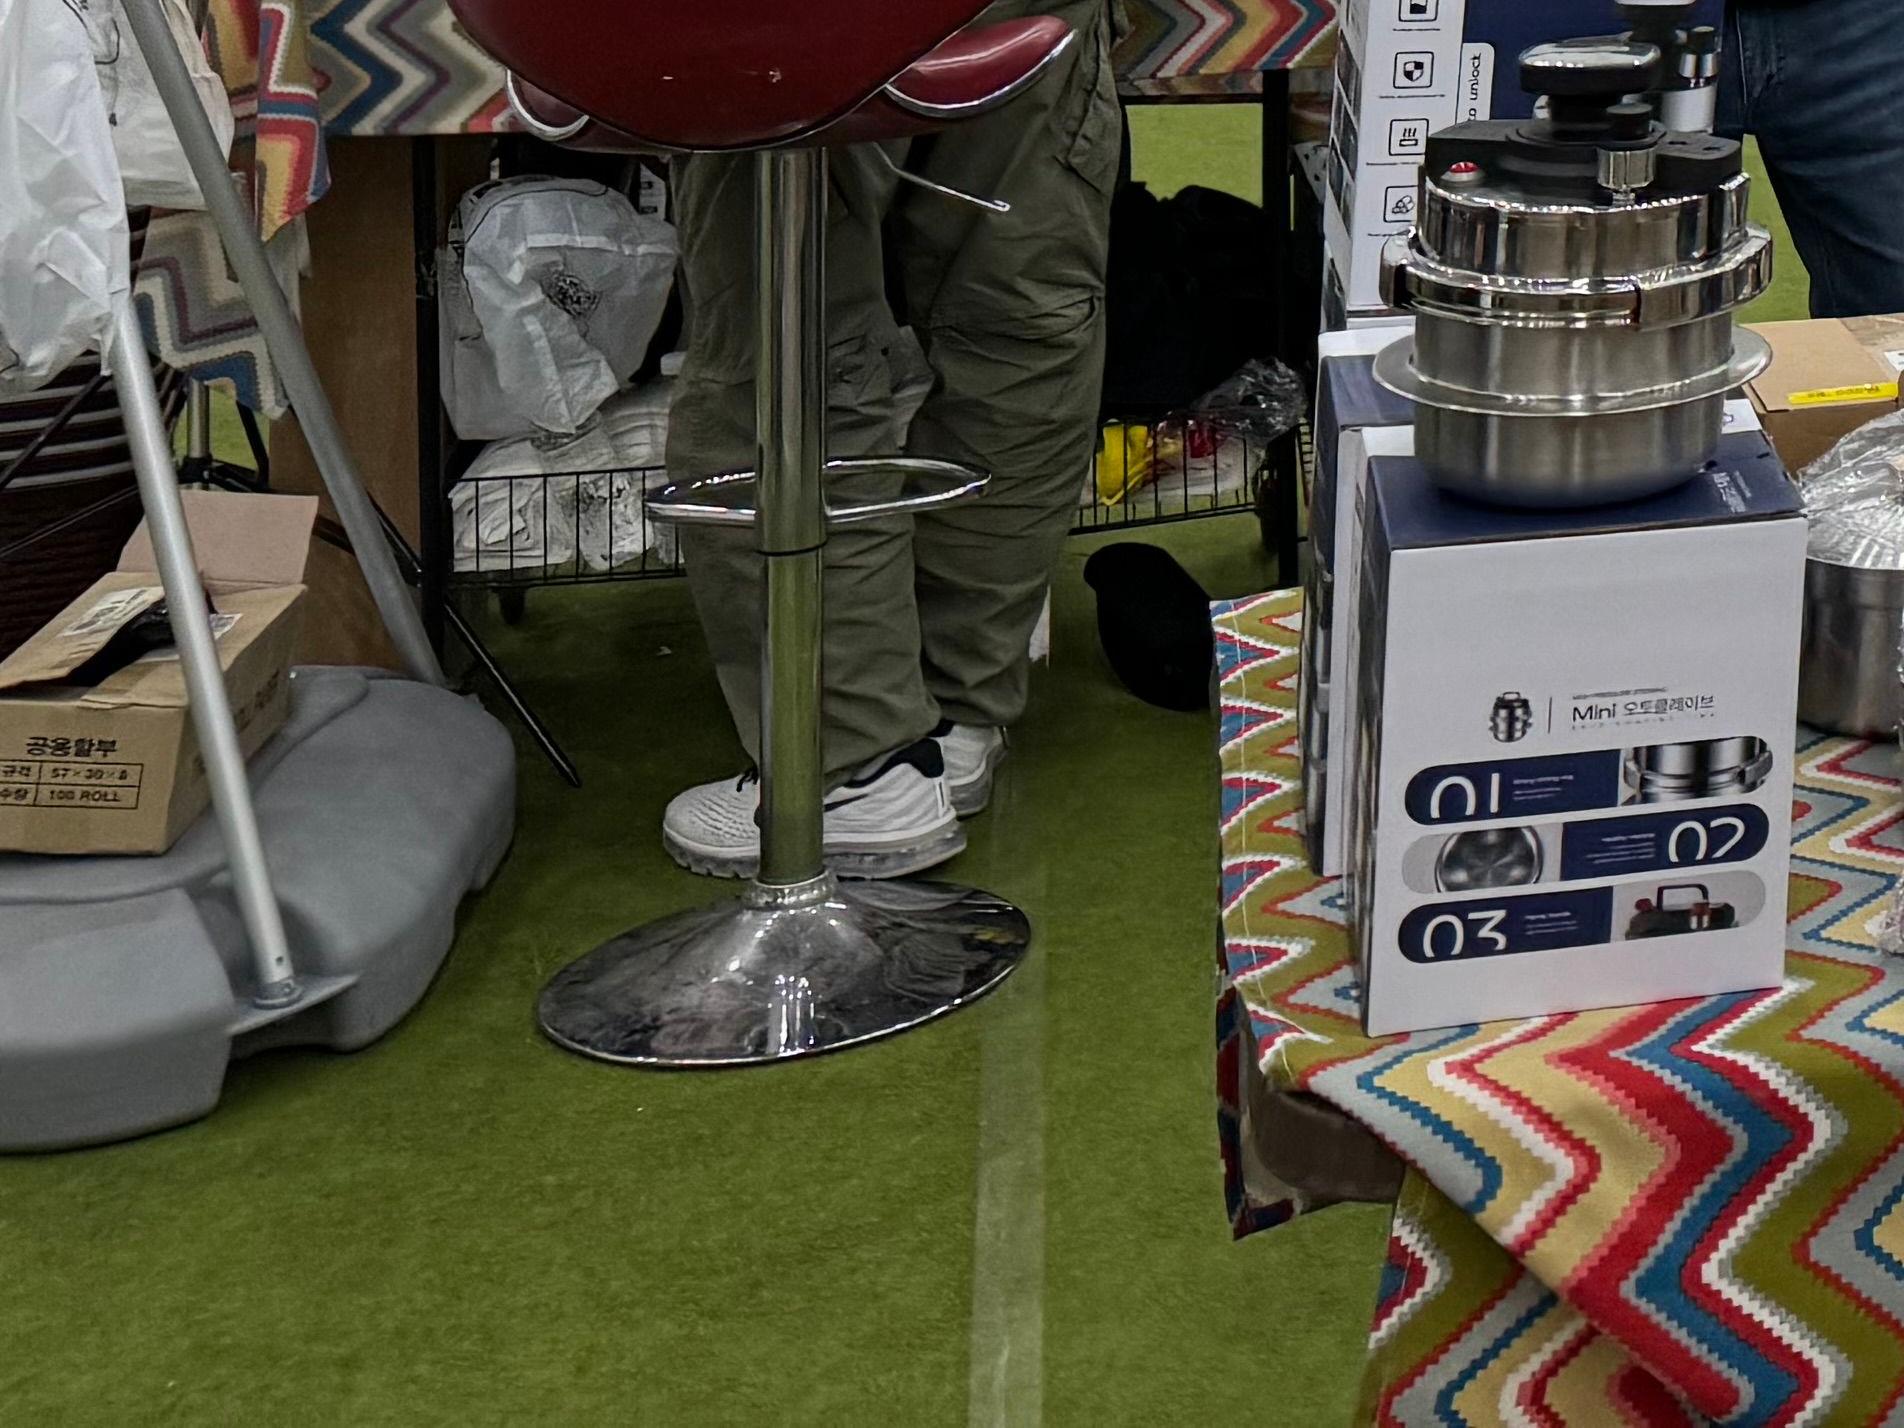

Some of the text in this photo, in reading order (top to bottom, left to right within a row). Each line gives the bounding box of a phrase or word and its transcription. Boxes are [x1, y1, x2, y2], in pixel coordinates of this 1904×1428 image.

[1572, 702, 1617, 723] Mini
[80, 790, 121, 802] ROLL
[1429, 772, 1500, 819] 01
[1667, 816, 1746, 863] 02
[1422, 909, 1508, 958] 03
